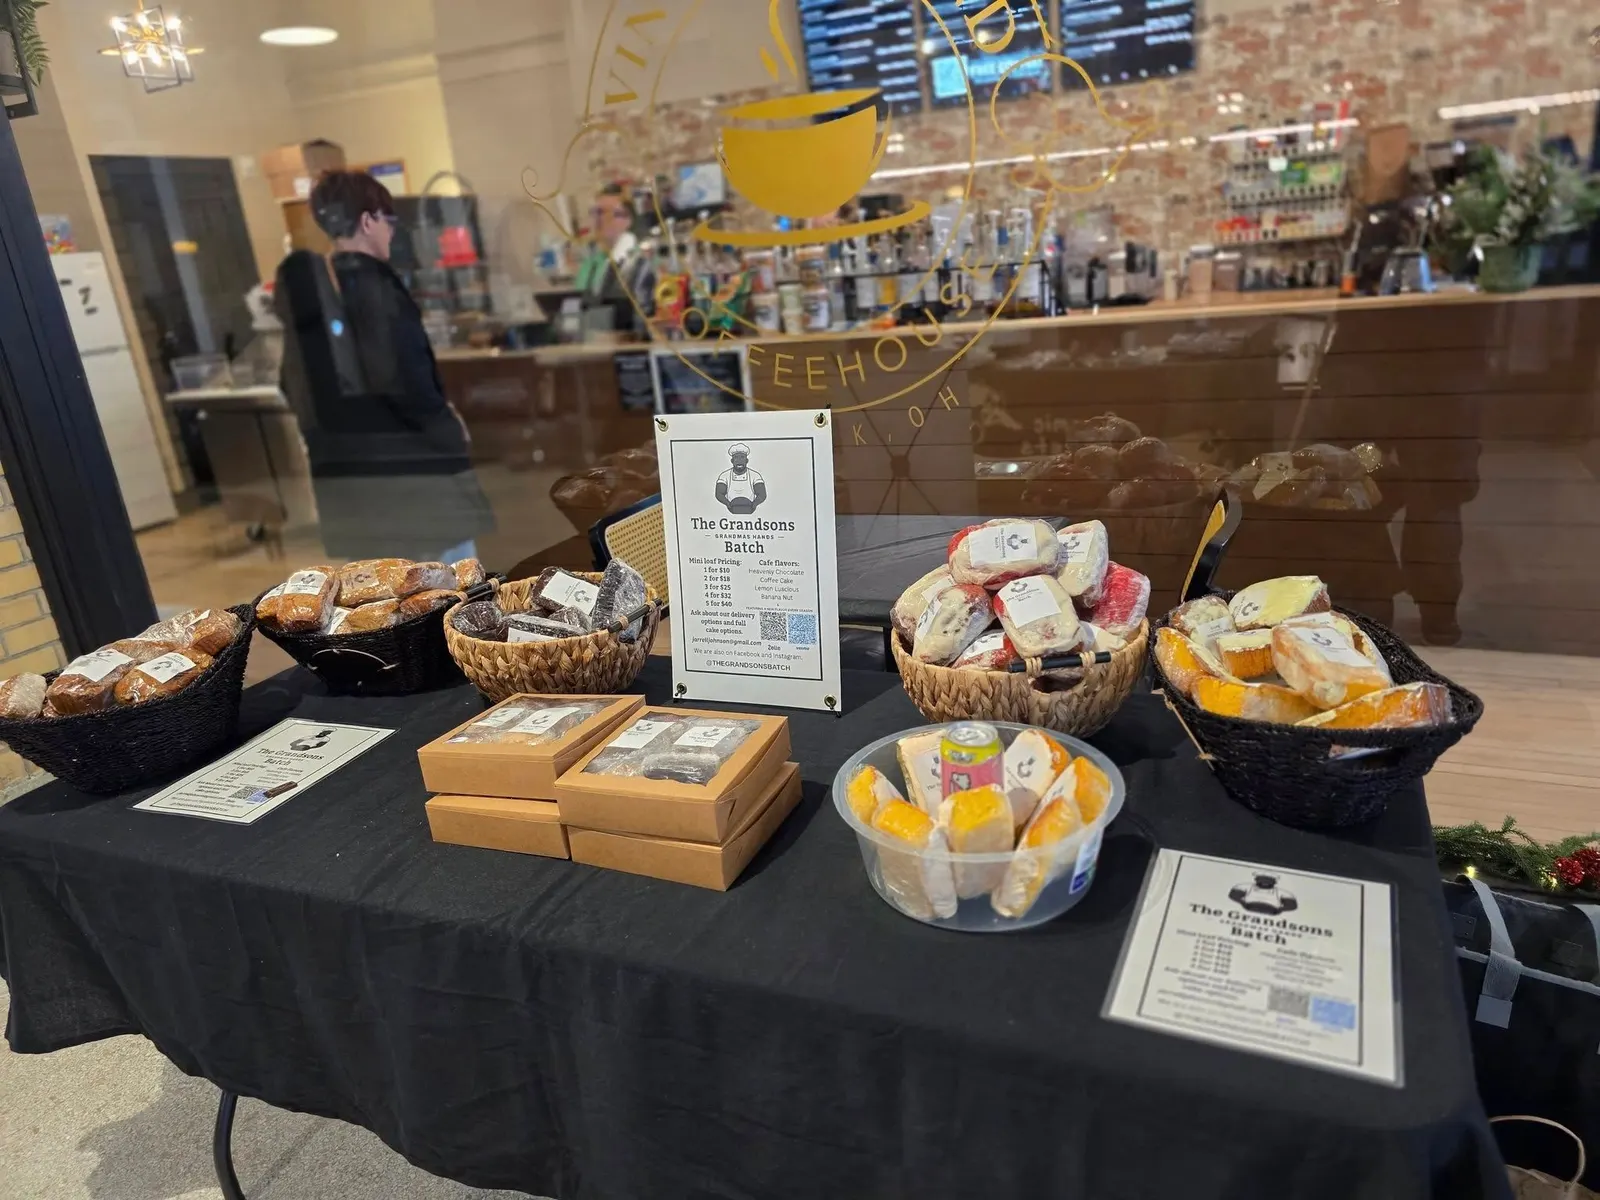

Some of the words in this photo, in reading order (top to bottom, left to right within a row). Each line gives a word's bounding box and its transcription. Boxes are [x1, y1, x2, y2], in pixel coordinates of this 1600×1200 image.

[690, 517, 716, 530] The
[719, 517, 796, 532] Grandsons
[724, 541, 765, 553] Batch
[717, 558, 743, 567] Pricing:
[730, 611, 756, 620] delivery
[719, 627, 744, 635] options.
[705, 660, 791, 671] @THEGRANDSONSBATCH
[275, 749, 325, 760] Grandsons
[264, 758, 291, 766] Batch
[1189, 903, 1223, 916] The
[1227, 909, 1334, 938] Grandsons
[1230, 926, 1287, 945] Batch
